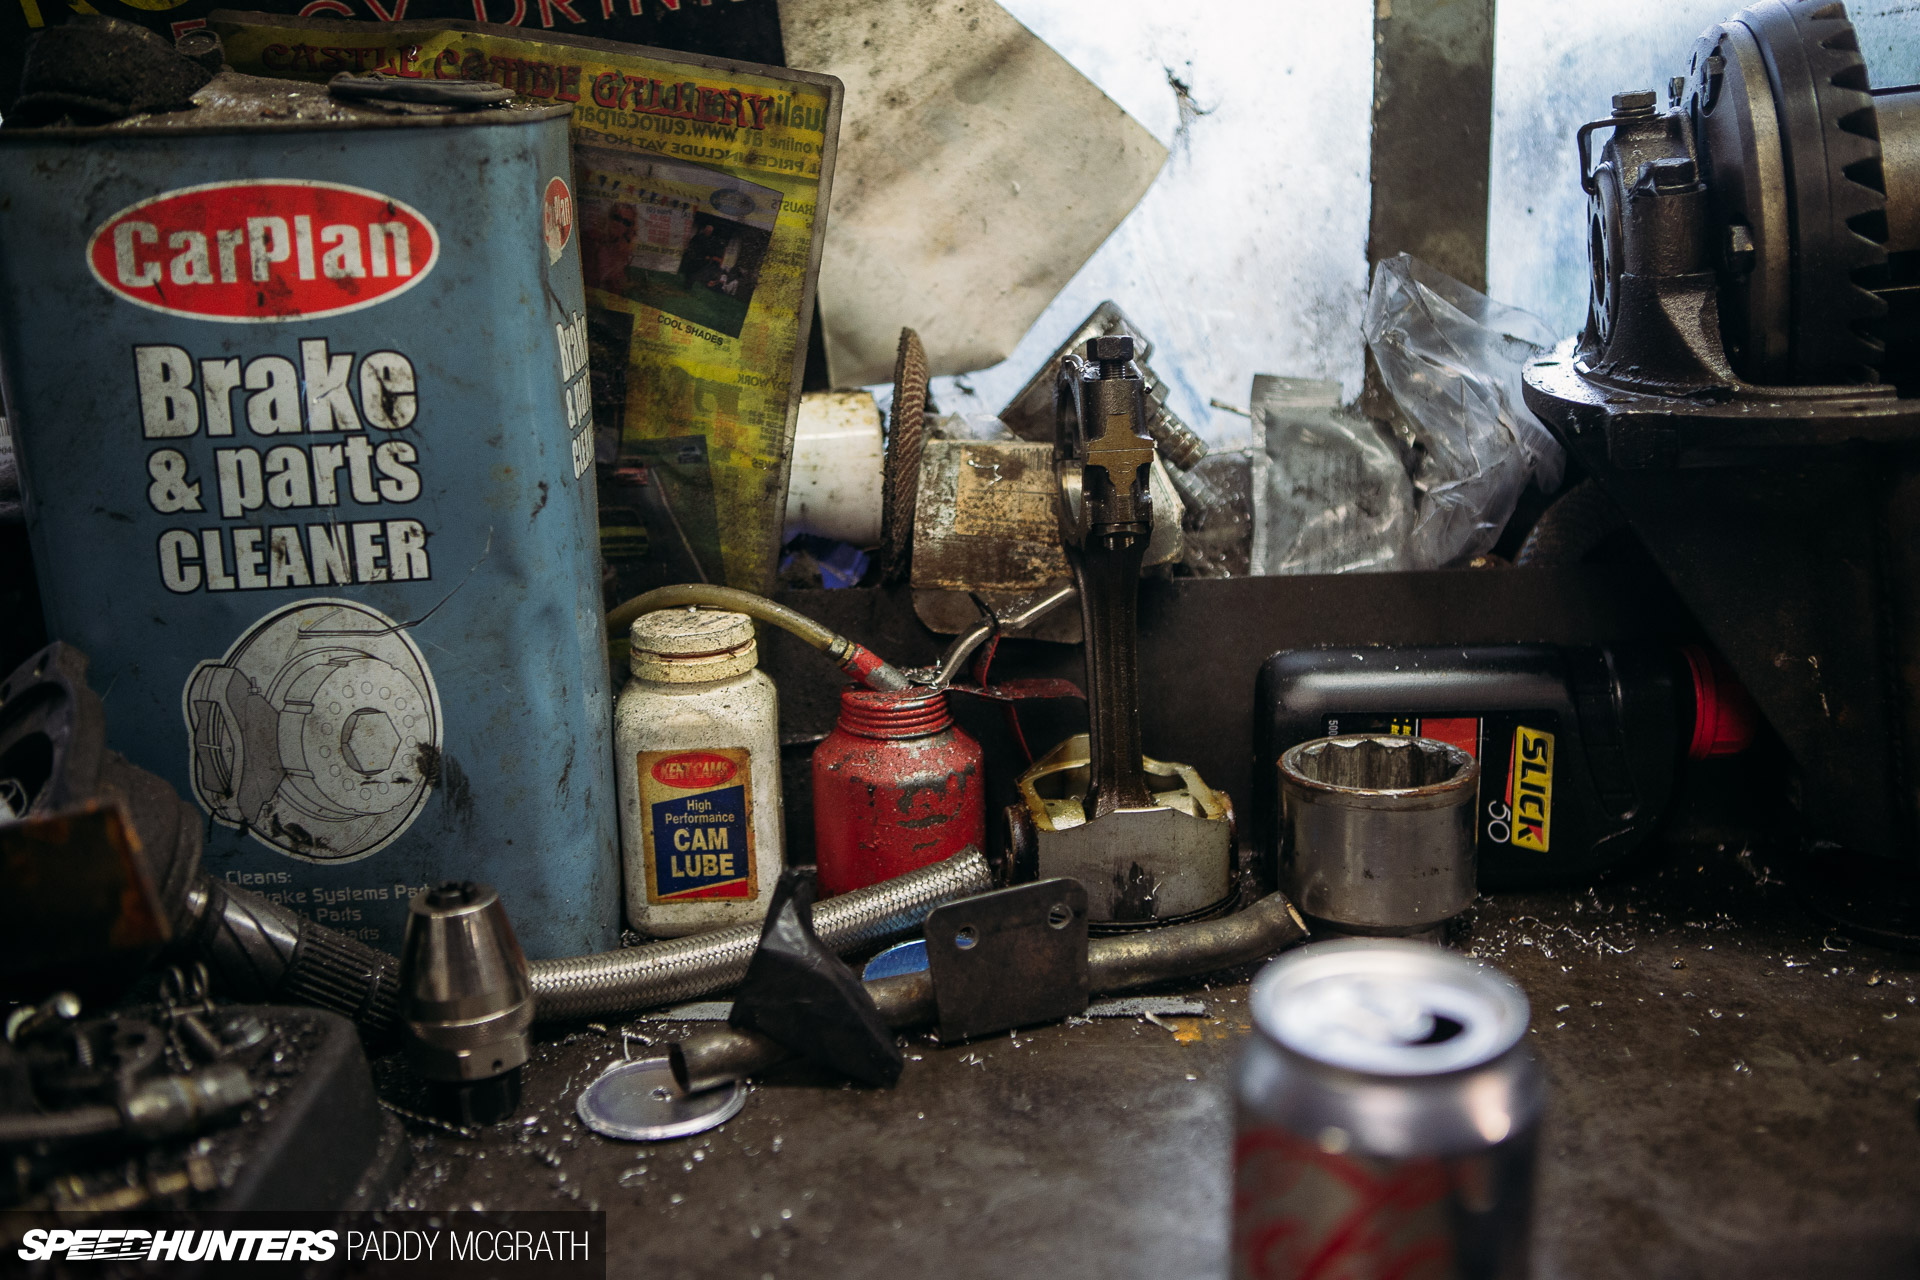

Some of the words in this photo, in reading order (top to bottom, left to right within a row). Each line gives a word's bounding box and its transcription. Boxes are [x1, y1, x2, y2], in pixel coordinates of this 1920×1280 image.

[593, 71, 776, 131] GALLERY
[112, 214, 413, 288] CarPlan
[657, 313, 684, 332] COOL
[684, 324, 724, 346] SHADES
[132, 337, 419, 440] Brake
[145, 448, 207, 514] &
[214, 434, 422, 520] parts
[156, 518, 432, 594] CLEANER
[686, 799, 712, 813] High
[1518, 732, 1549, 846] SLICK
[665, 812, 736, 825] Performance
[1487, 799, 1512, 844] 50
[673, 827, 729, 852] CAM
[670, 853, 736, 878] LUBE
[312, 887, 390, 906] Systems
[317, 908, 363, 923] Parts
